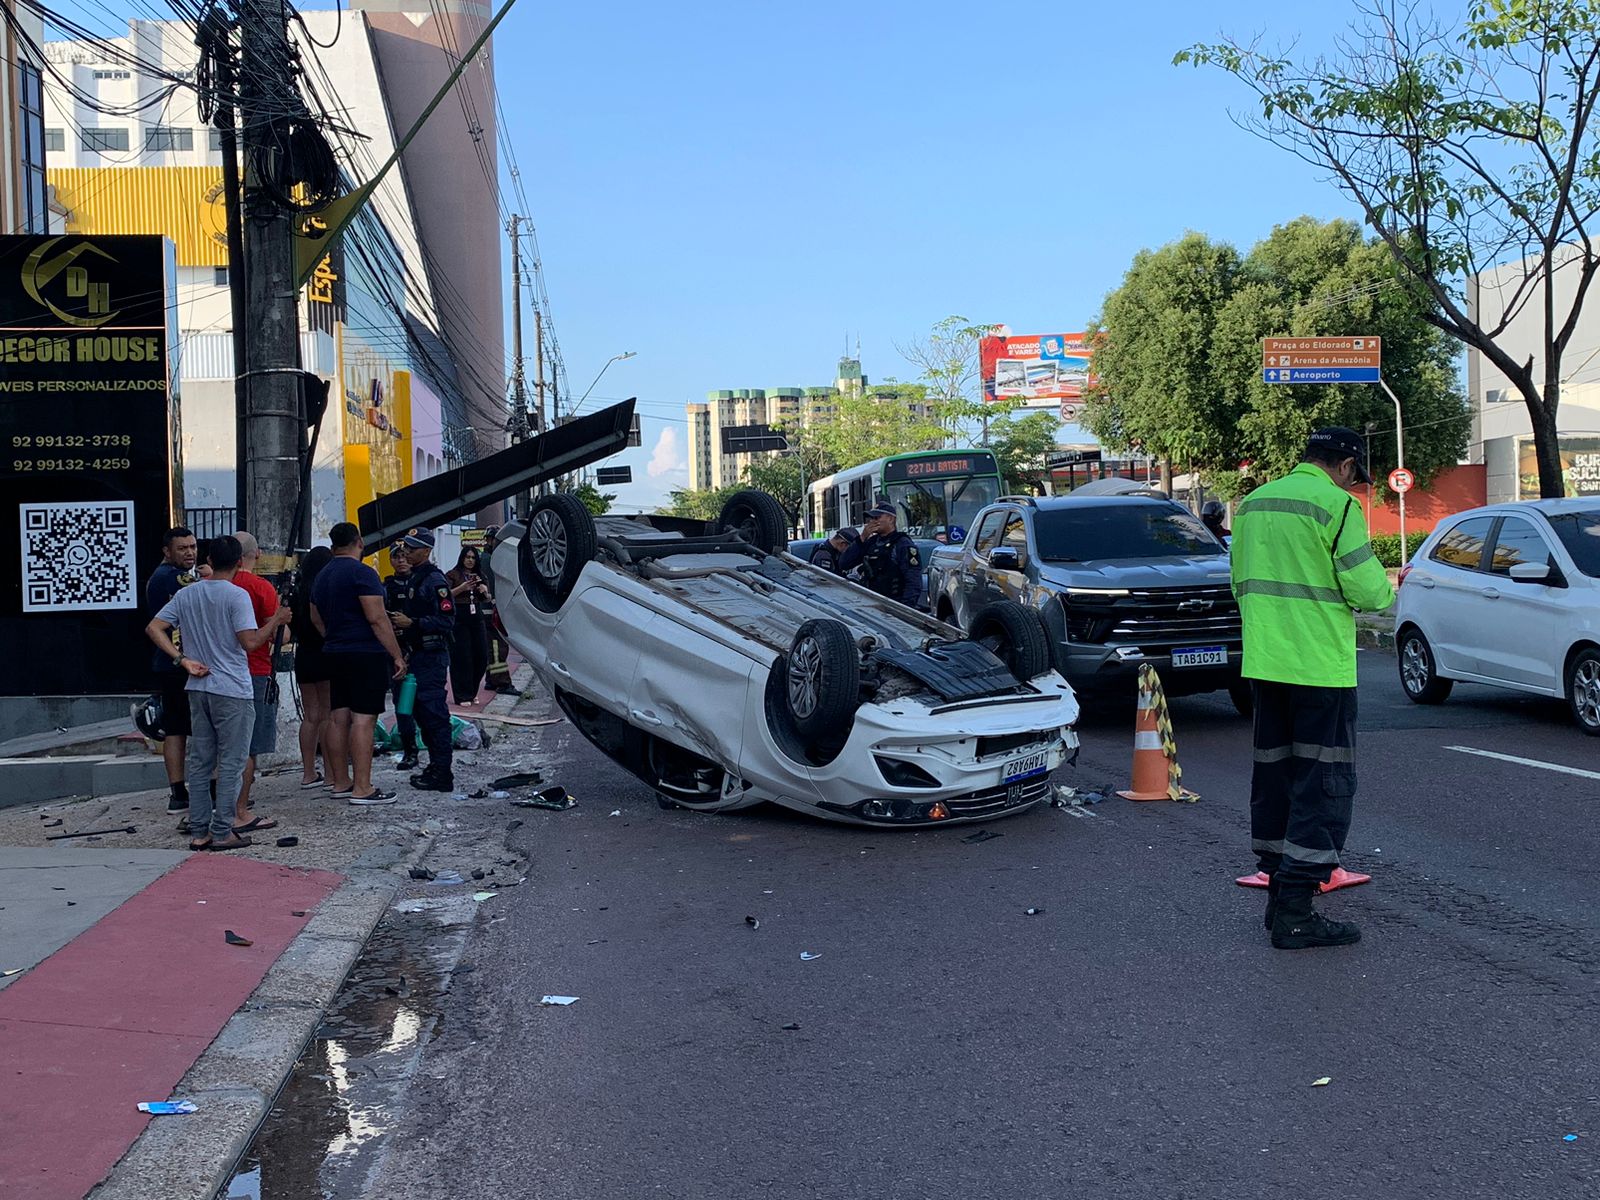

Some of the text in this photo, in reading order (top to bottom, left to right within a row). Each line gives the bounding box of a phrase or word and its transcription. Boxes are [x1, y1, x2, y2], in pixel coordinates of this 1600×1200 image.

[76, 337, 160, 362] HOUSE
[1007, 342, 1040, 350] ATACADO
[1272, 341, 1351, 350] Praça do Eldorado
[1293, 356, 1371, 364] Arena da Amazônia
[1293, 371, 1341, 380] Aeroporto
[37, 380, 167, 392] PERSONALIZADOS
[12, 434, 131, 447] 92 99132-3738
[13, 458, 131, 471] 92 99132-4259
[908, 463, 924, 474] 227
[925, 462, 936, 473] DJ
[1177, 652, 1222, 665] TAB1C91
[1007, 753, 1044, 776] TAH9A82
